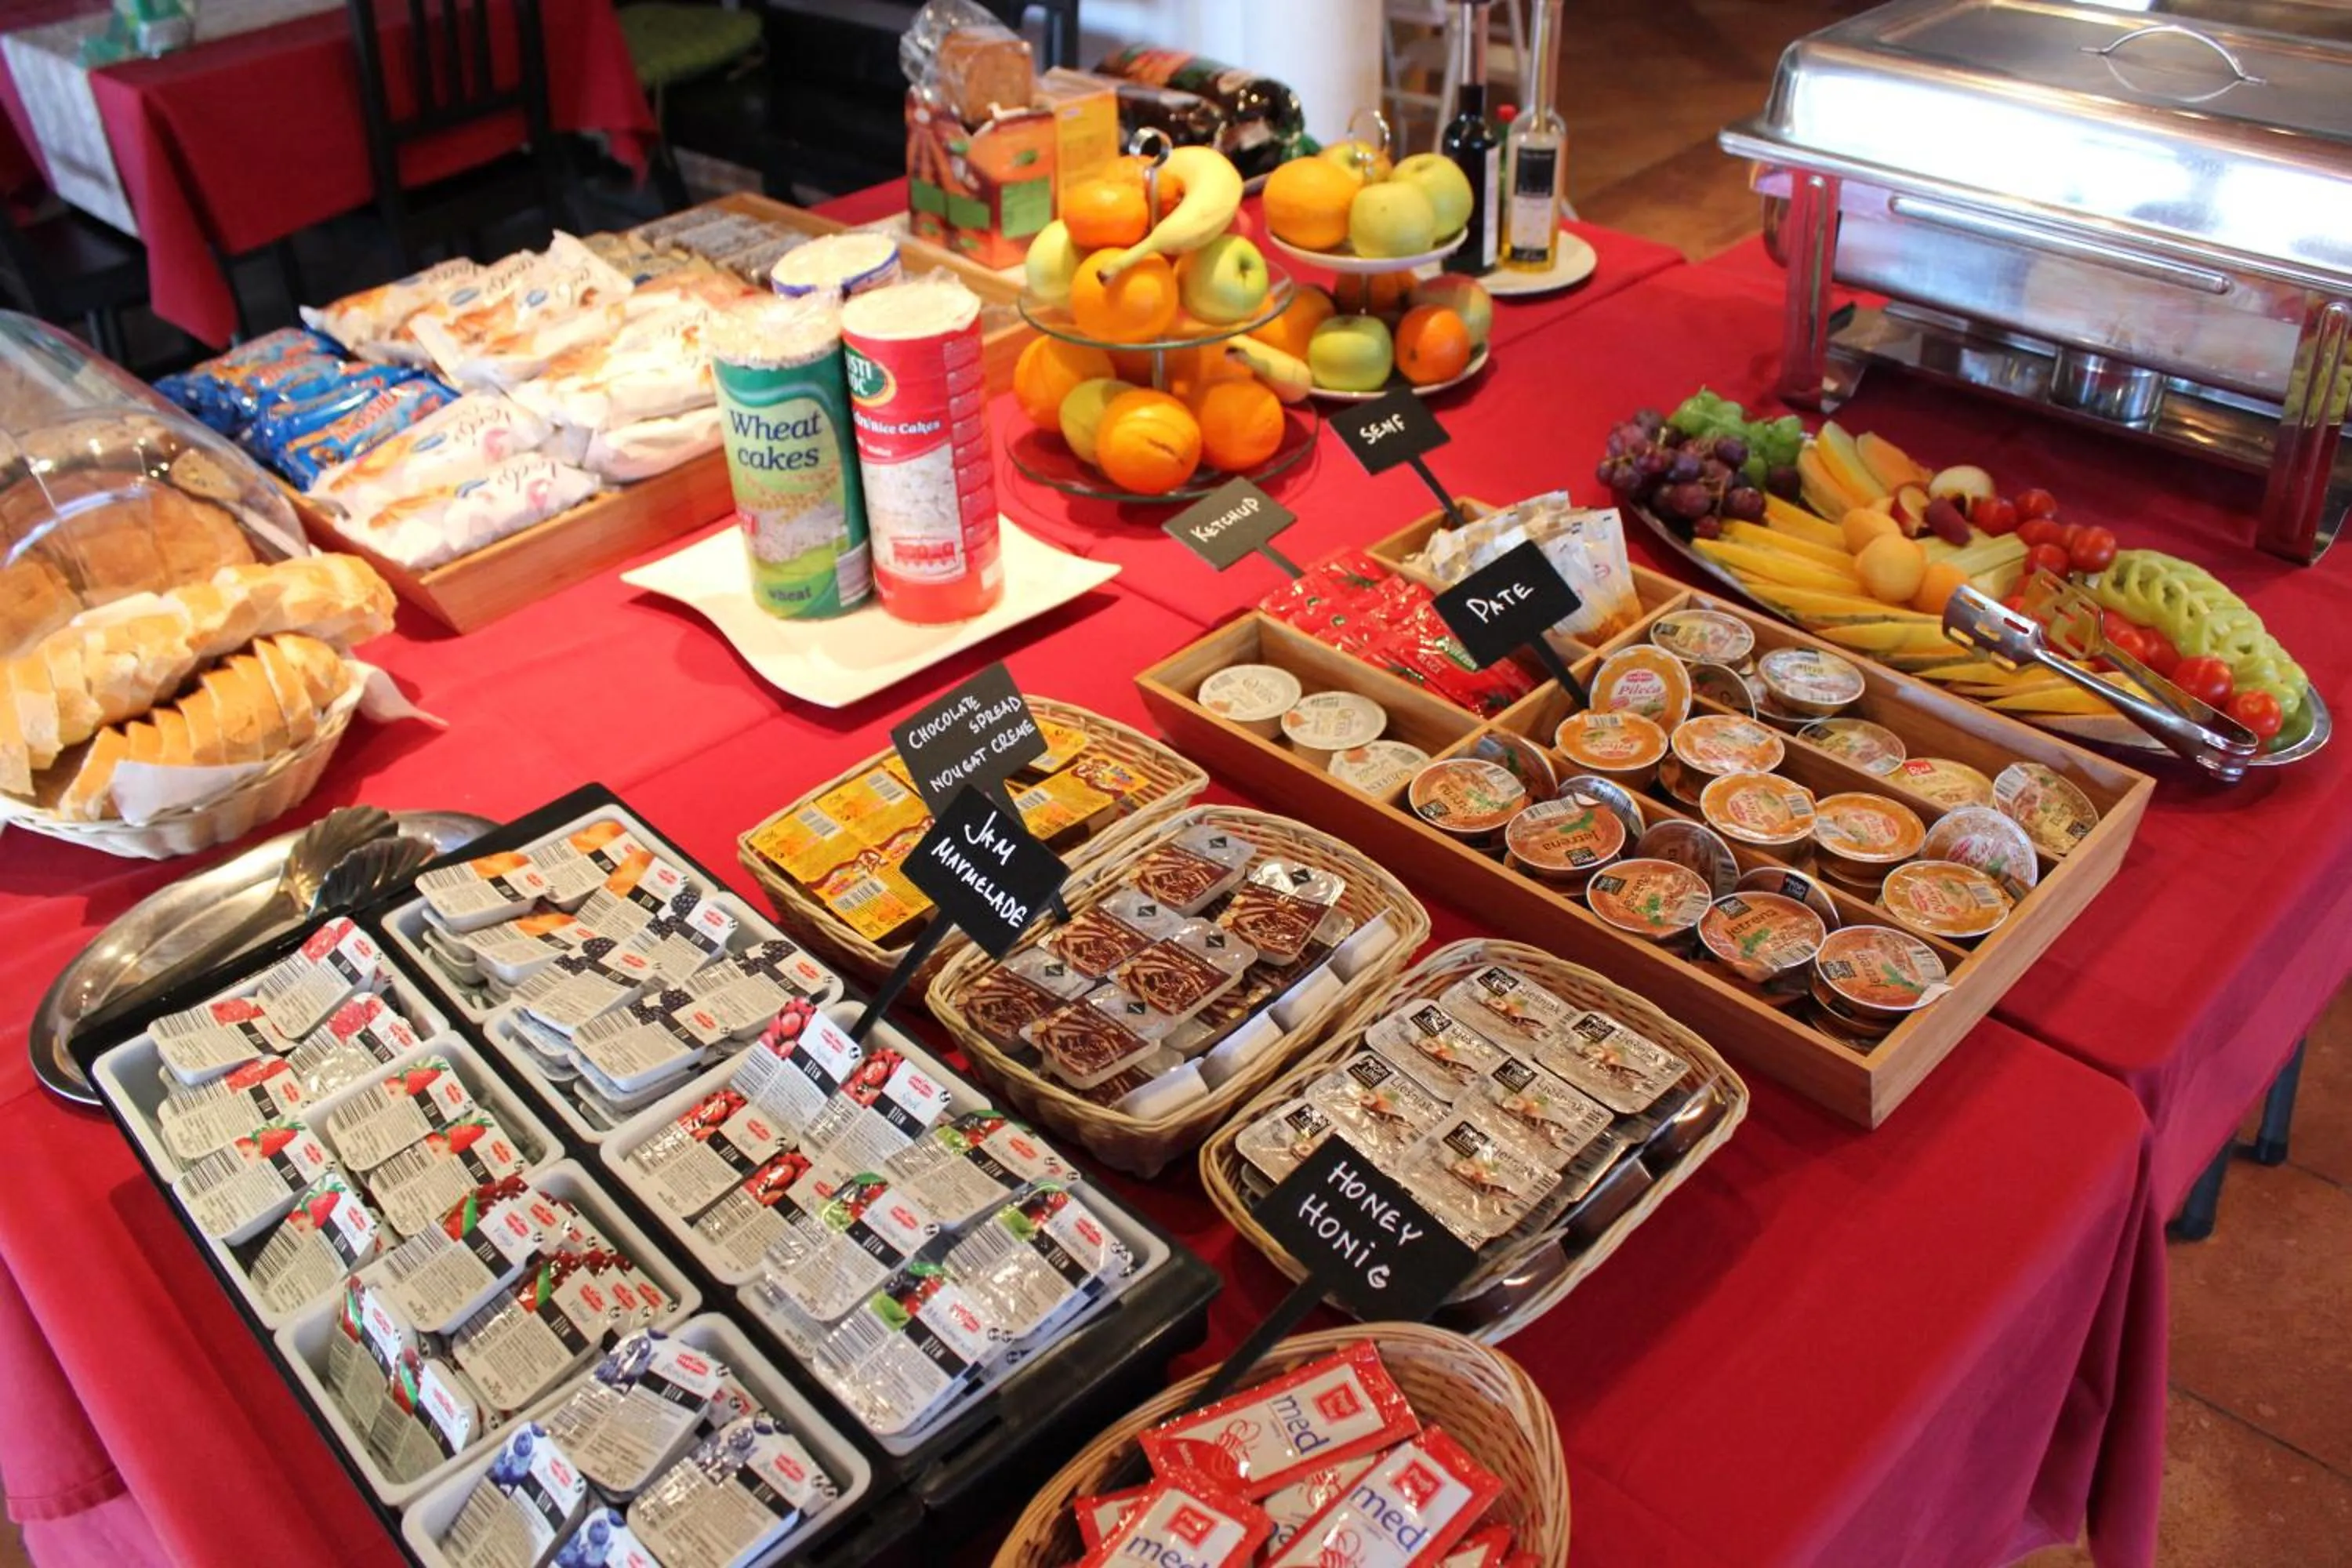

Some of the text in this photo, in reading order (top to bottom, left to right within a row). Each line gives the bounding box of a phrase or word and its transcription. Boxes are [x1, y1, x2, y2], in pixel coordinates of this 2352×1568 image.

[729, 409, 822, 442] Wheat
[898, 420, 941, 434] Cakes
[1358, 413, 1406, 445] SENF
[737, 439, 820, 471] cakes
[1190, 496, 1261, 543] KETCHUP
[1466, 581, 1534, 624] PATE
[908, 694, 982, 750] CHOCOLATE
[968, 695, 1022, 735] SPREAD
[930, 719, 1036, 793] NOUGAT CREME
[964, 810, 1017, 866] JAM
[931, 837, 1027, 929] MARMELADE
[1328, 1161, 1424, 1247] HONEY
[1272, 1394, 1330, 1456] med
[1349, 1484, 1428, 1553] med
[1125, 1535, 1210, 1568] me
